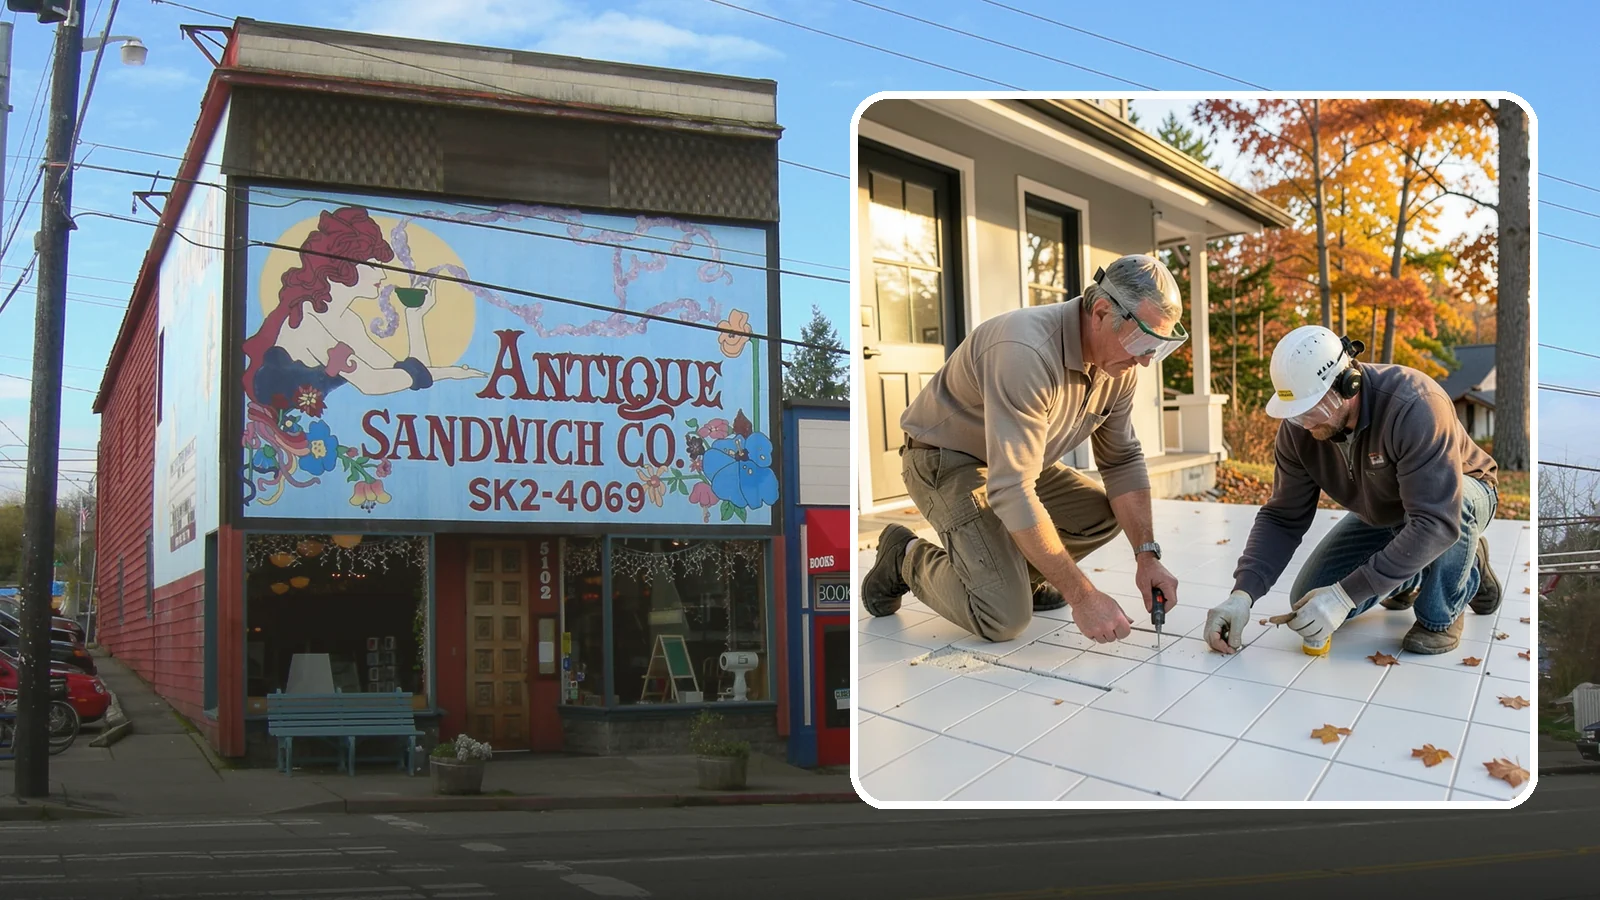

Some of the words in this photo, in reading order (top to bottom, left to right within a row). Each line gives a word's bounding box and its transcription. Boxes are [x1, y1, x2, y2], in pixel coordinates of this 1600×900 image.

[475, 329, 723, 420] ANTIQUE
[361, 408, 604, 467] SANDWICH
[617, 421, 685, 468] CO.
[468, 477, 645, 513] SK2-4069
[539, 542, 551, 600] 5102
[809, 555, 835, 569] BOOKS
